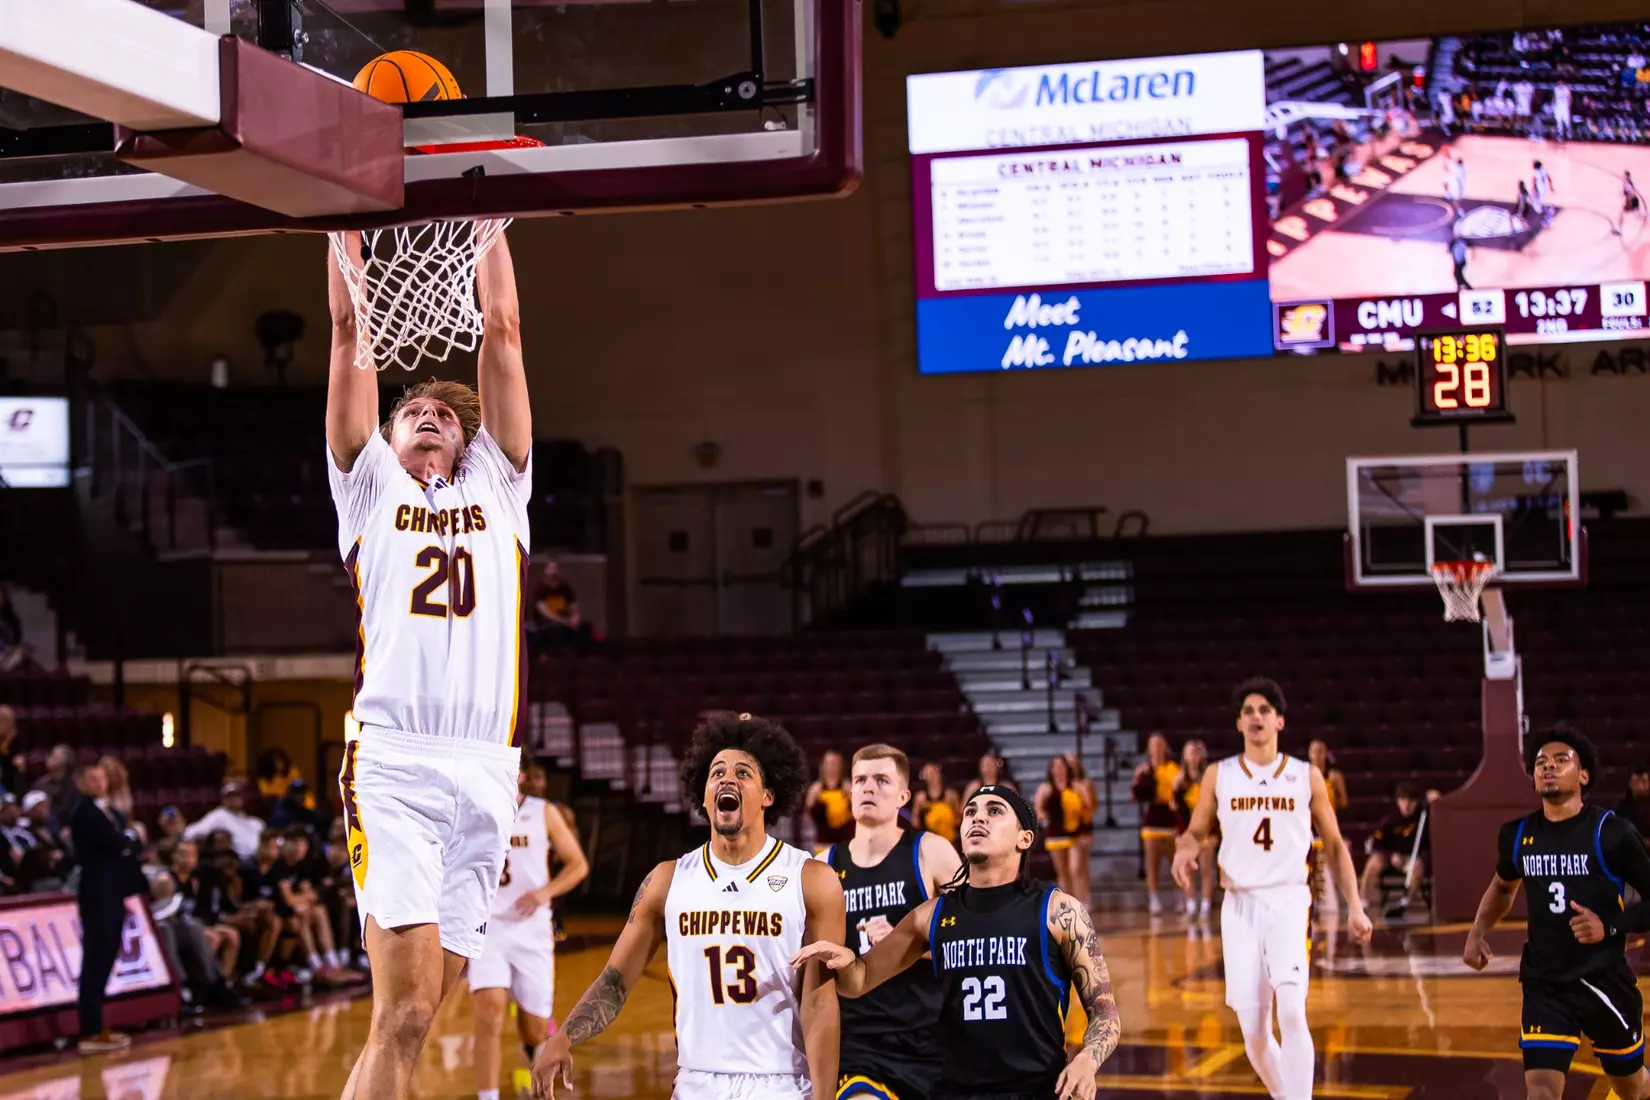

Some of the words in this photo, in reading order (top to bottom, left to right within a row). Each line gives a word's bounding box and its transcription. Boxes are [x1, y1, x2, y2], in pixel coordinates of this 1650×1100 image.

[1036, 69, 1195, 107] McLaren
[998, 158, 1082, 178] CENTRAL
[1090, 153, 1183, 171] MICHIGAN
[1004, 293, 1081, 330] Meet
[1357, 298, 1423, 329] CMU
[1514, 288, 1588, 318] 13:37
[1612, 292, 1635, 307] 30
[1001, 333, 1055, 370] Mt.
[1062, 329, 1189, 367] Pleasant
[1432, 333, 1496, 363] 13:36
[1434, 361, 1491, 409] 28
[409, 543, 477, 620] 20
[1230, 795, 1296, 813] CHIPPEWAS
[1252, 816, 1275, 853] 4
[1522, 854, 1558, 876] NORTH
[1560, 853, 1590, 876] PARK
[875, 879, 906, 908] PARK
[1548, 881, 1567, 914] 3
[678, 910, 783, 938] CHIPPEWAS
[942, 937, 985, 971] NORTH
[988, 936, 1028, 966] PARK
[703, 944, 759, 1006] 13
[961, 975, 1008, 1021] 22
